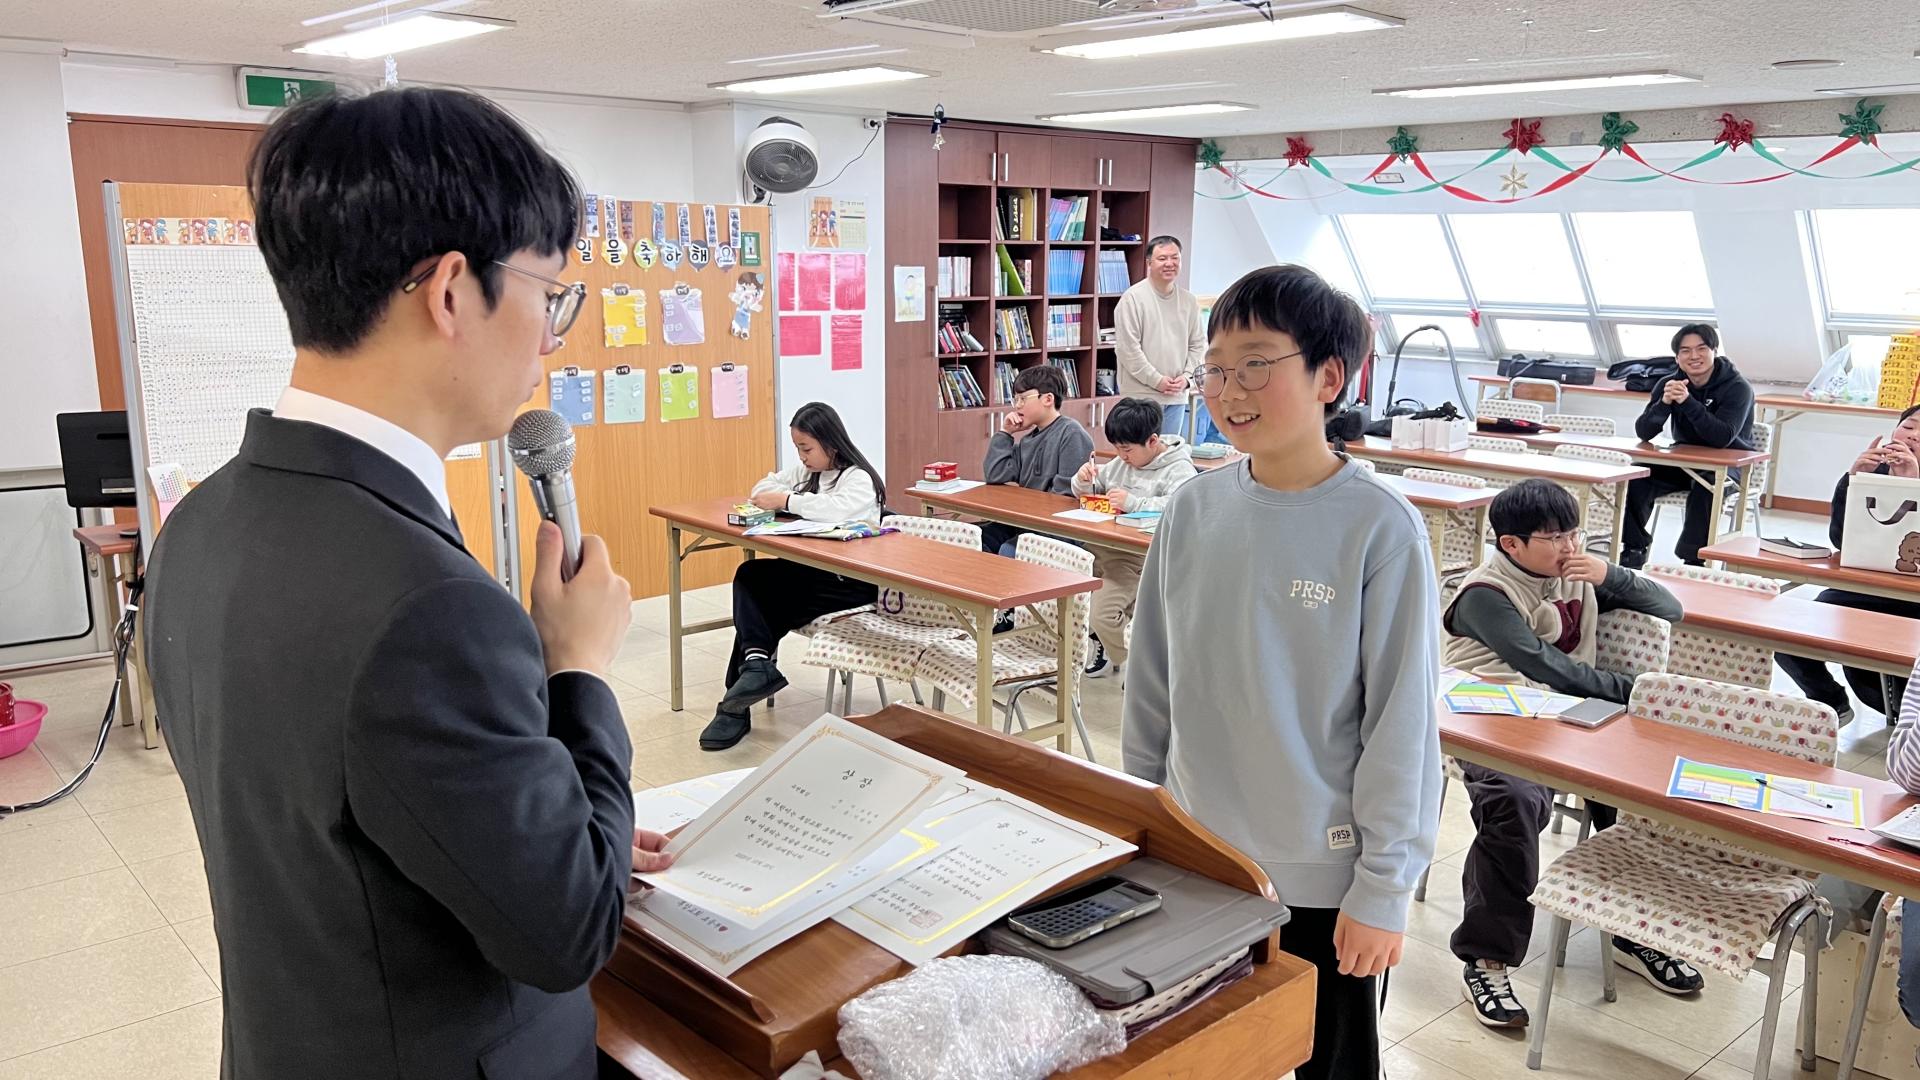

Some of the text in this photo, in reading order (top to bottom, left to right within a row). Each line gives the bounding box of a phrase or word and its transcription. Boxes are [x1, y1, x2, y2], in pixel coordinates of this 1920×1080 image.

[1289, 579, 1336, 604] PRSP
[743, 815, 758, 825] 함께
[1331, 829, 1351, 842] PRSP
